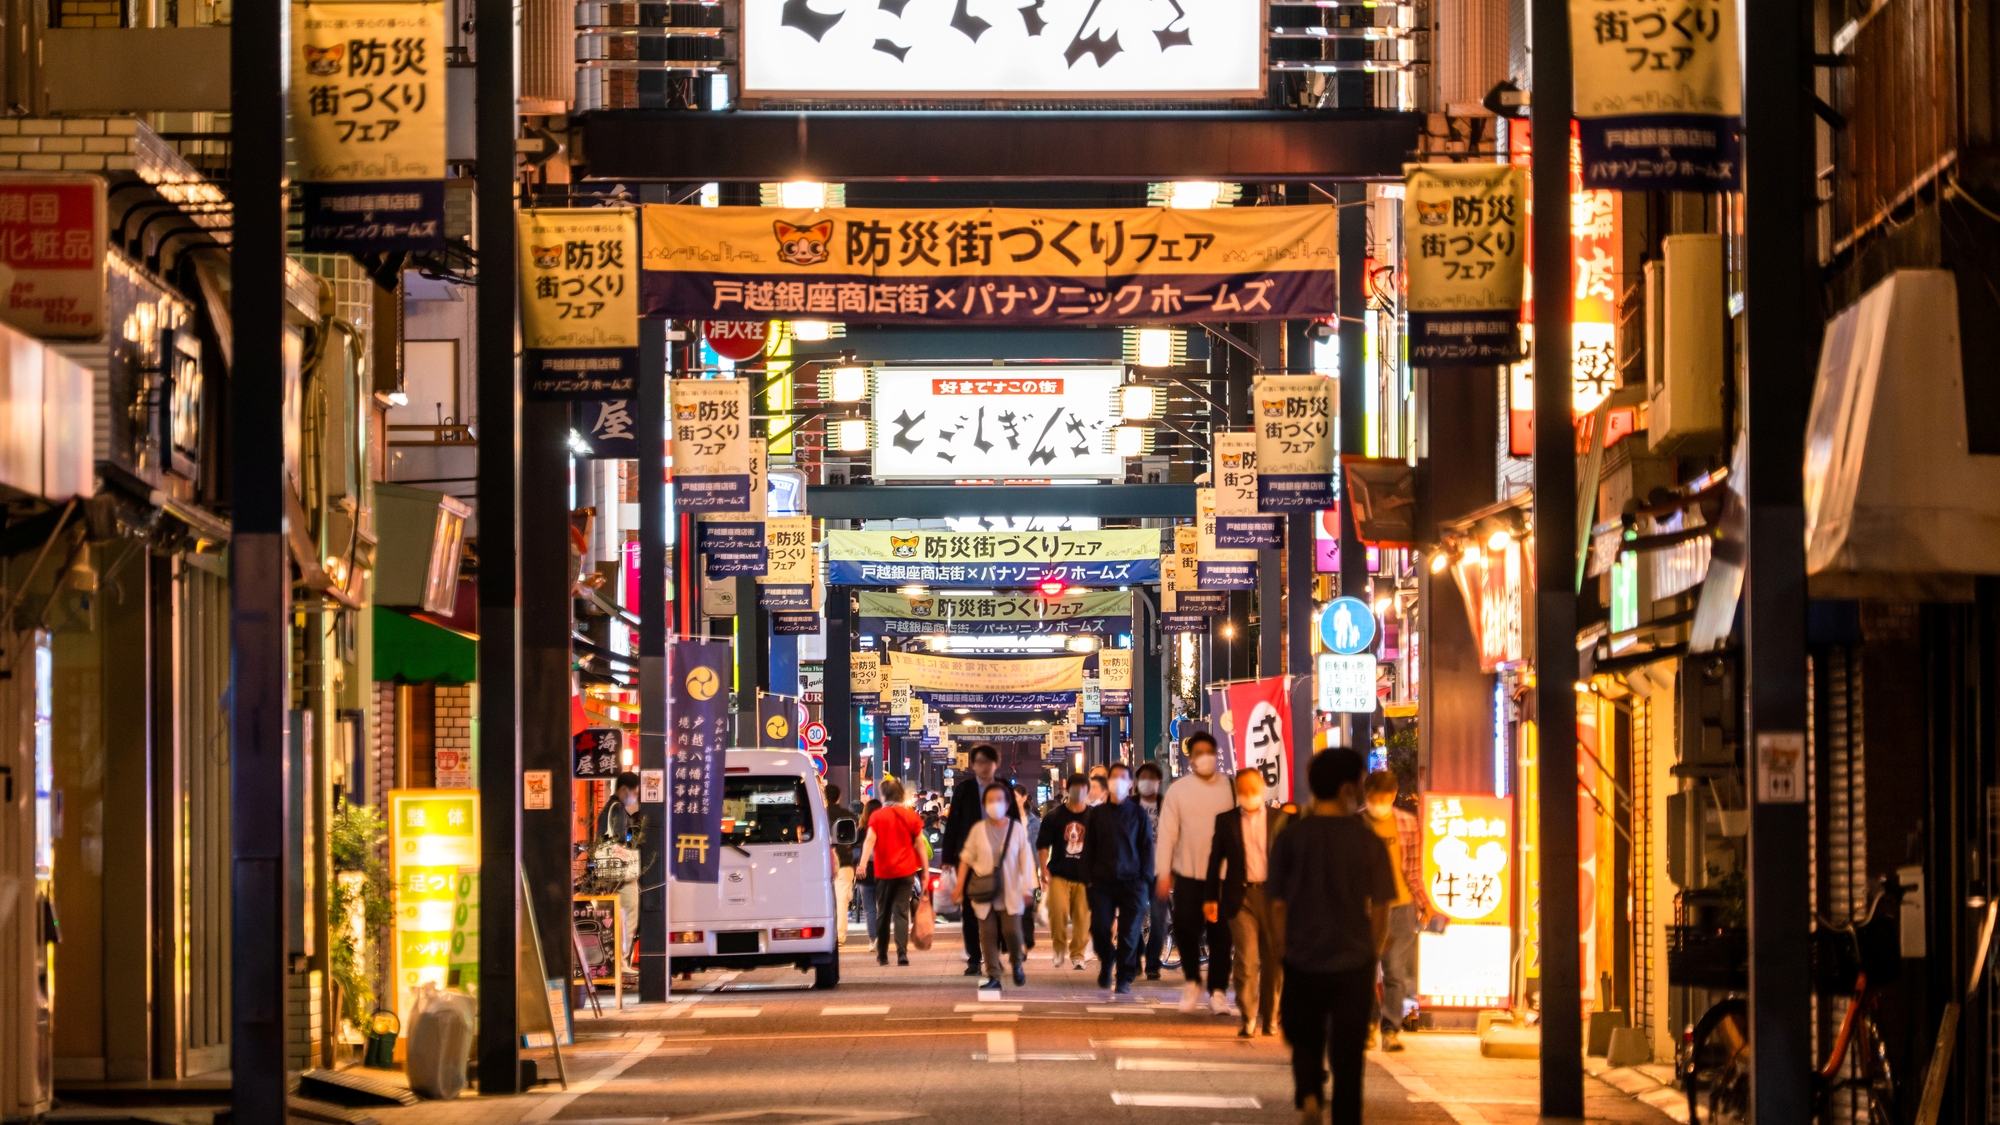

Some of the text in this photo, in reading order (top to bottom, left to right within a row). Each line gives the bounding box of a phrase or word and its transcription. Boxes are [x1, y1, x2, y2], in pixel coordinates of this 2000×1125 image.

[1593, 8, 1720, 44] 街づくり
[347, 38, 428, 78] 防災
[1625, 46, 1695, 72] フェア
[308, 83, 427, 117] 街づくり
[335, 119, 400, 143] フェア
[1605, 130, 1717, 149] 戸越銀座商店街
[1591, 160, 1734, 178] パナソニック ホームズ
[320, 194, 422, 212] 戸越銀座商店街
[1453, 195, 1516, 228] 防災
[310, 220, 437, 239] パナソニック ホームズ
[845, 218, 1216, 268] 防災街づくりフェア
[1421, 231, 1516, 258] 街づくり
[565, 240, 624, 270] 防災
[1443, 261, 1496, 280] フェア
[536, 274, 624, 299] 街づくり
[9, 296, 79, 311] Beauty
[556, 302, 605, 319] フェア
[43, 309, 95, 327] Shop
[1425, 322, 1510, 335] 戸越銀座商店街
[541, 358, 621, 371] 戸越銀座商店街
[533, 378, 633, 391] パナソニック ホームズ
[938, 380, 1058, 394] 好きですこの街
[699, 400, 740, 421] 防災
[1286, 396, 1329, 419] 防災
[677, 425, 740, 442] 街づくり
[891, 405, 1104, 467] とごしぎんざ
[1265, 421, 1329, 440] 街づくり
[693, 443, 726, 456] フェア
[1280, 441, 1316, 454] フェア
[1242, 451, 1257, 470] 防
[681, 482, 737, 492] 戸越銀座商店街
[1224, 472, 1258, 487] 街づ
[1269, 481, 1326, 491] 戸越銀座商店街
[674, 496, 745, 506] パナソニック ホームズ
[1261, 496, 1333, 506] パナソニック ホームズ
[706, 528, 755, 537] 戸越銀座商店街
[1226, 522, 1275, 531] 戸越銀座商店街
[776, 531, 806, 546] 防災
[924, 535, 1103, 559] 防災街づくりフェア
[772, 561, 796, 571] フェア
[1206, 566, 1249, 575] 戸越銀座商店街
[764, 588, 804, 596] 戸越銀座商店街
[937, 597, 1084, 618] 防災街づくりフェア
[858, 661, 877, 670] 防災
[1111, 658, 1129, 667] 防災
[892, 689, 908, 697] 防災
[809, 728, 822, 740] 30
[598, 732, 618, 775] 海鮮
[687, 716, 705, 815] 戸越八幡神社
